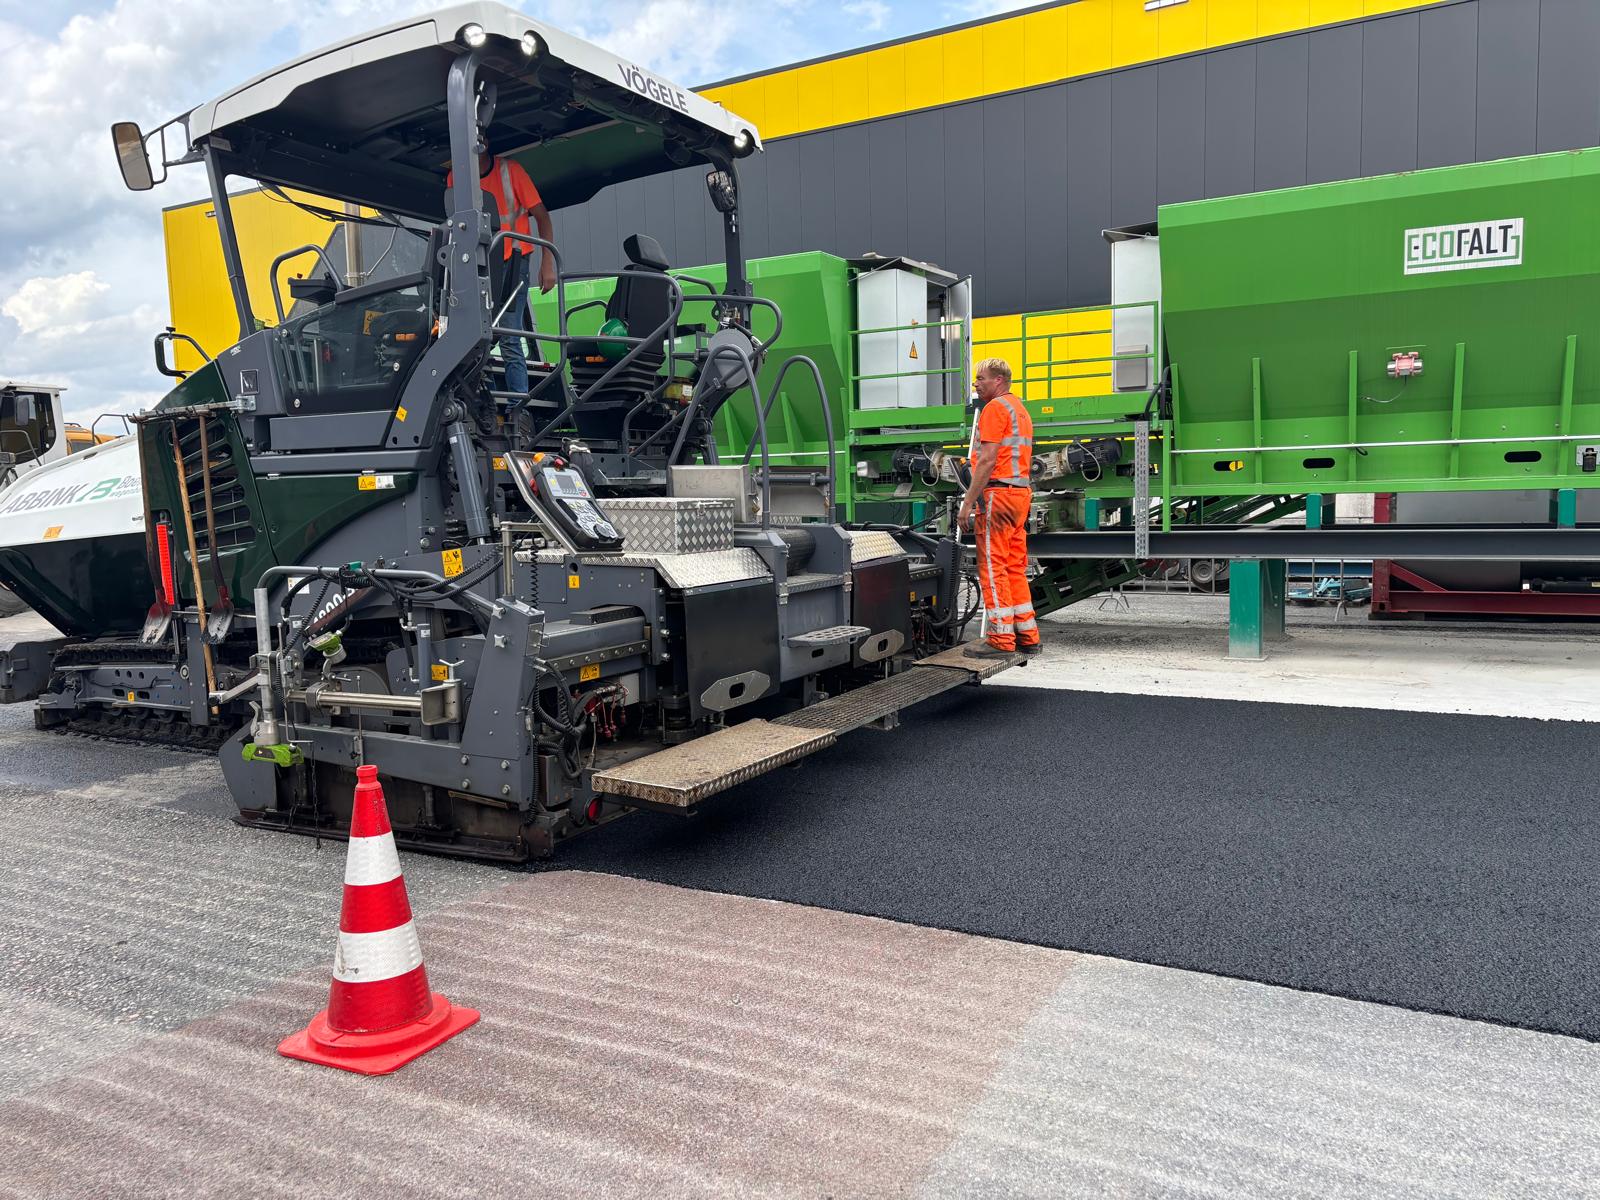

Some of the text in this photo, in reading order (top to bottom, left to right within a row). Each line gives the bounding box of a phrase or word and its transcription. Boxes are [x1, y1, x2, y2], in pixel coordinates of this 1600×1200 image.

[617, 63, 689, 113] VÖGELE
[1407, 224, 1518, 262] ECOFALT
[0, 483, 88, 513] ABBINK
